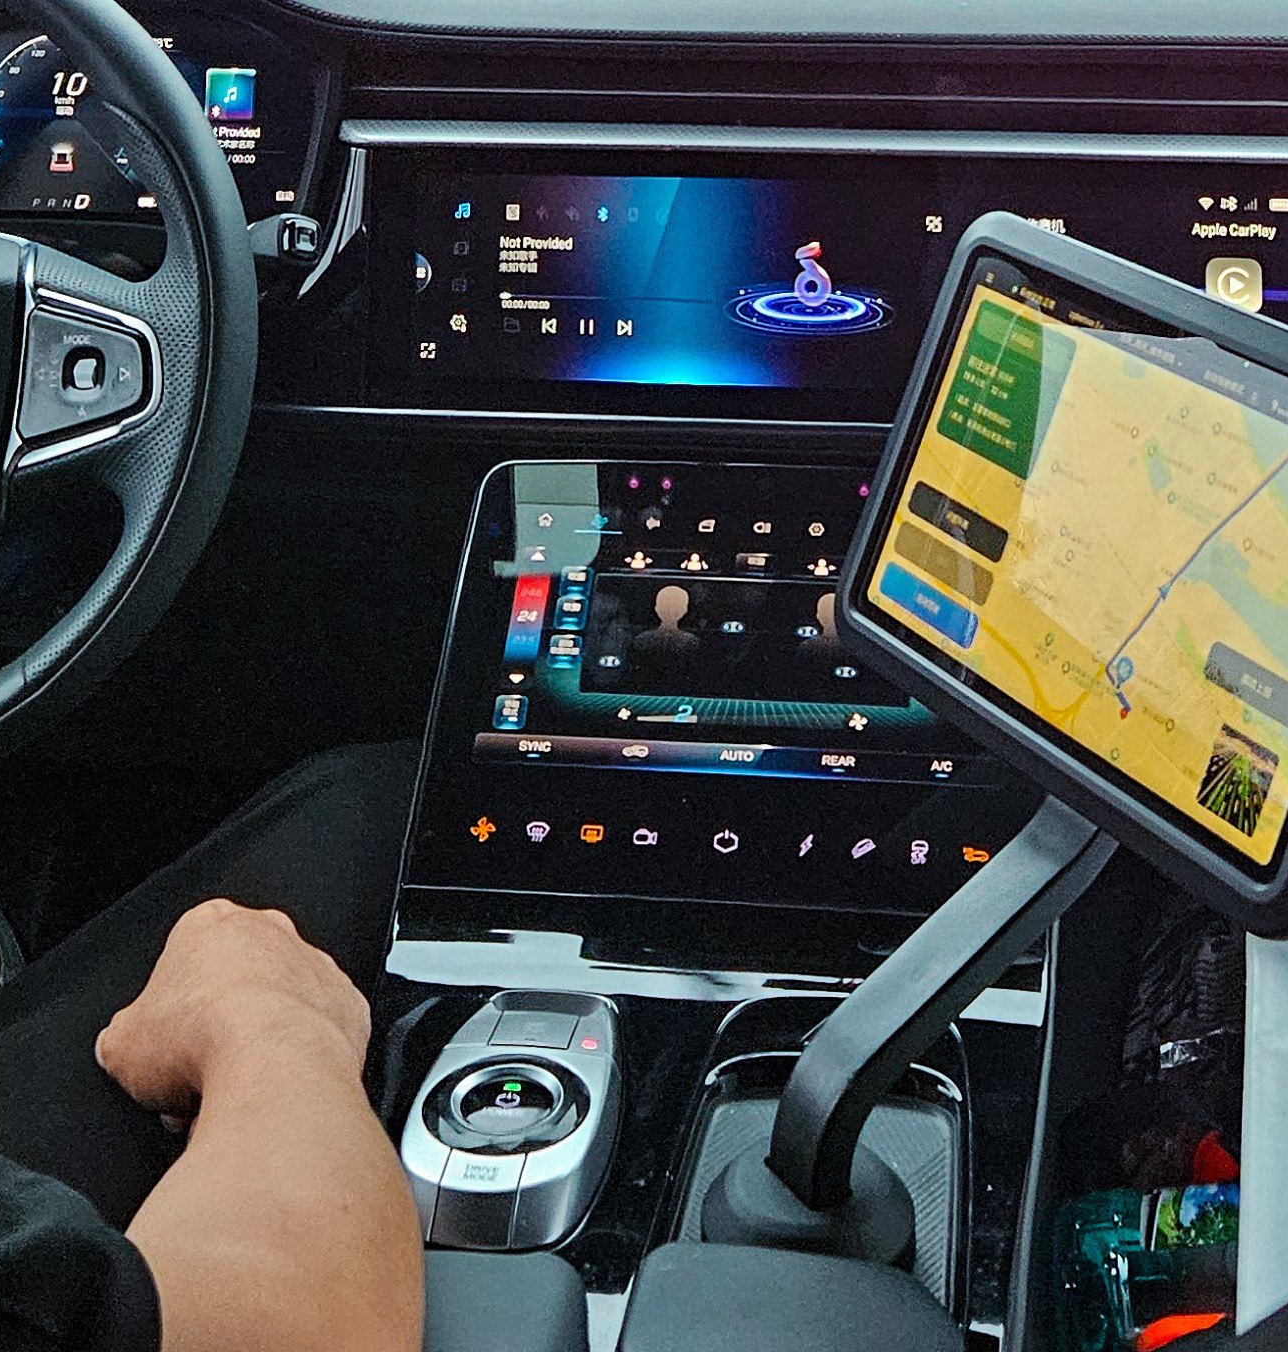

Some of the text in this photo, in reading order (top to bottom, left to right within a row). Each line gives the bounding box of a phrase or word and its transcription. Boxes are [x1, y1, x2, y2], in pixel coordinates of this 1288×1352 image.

[52, 72, 88, 96] 10
[219, 126, 261, 138] Provided
[73, 194, 91, 210] D
[1192, 223, 1277, 240] Apple CarPlay
[499, 236, 573, 250] Not Provided
[63, 335, 93, 345] MODE
[516, 610, 539, 622] 24
[518, 740, 552, 752] SYNC
[719, 749, 755, 762] AUTO
[821, 755, 856, 767] REAR
[930, 759, 953, 772] A/C
